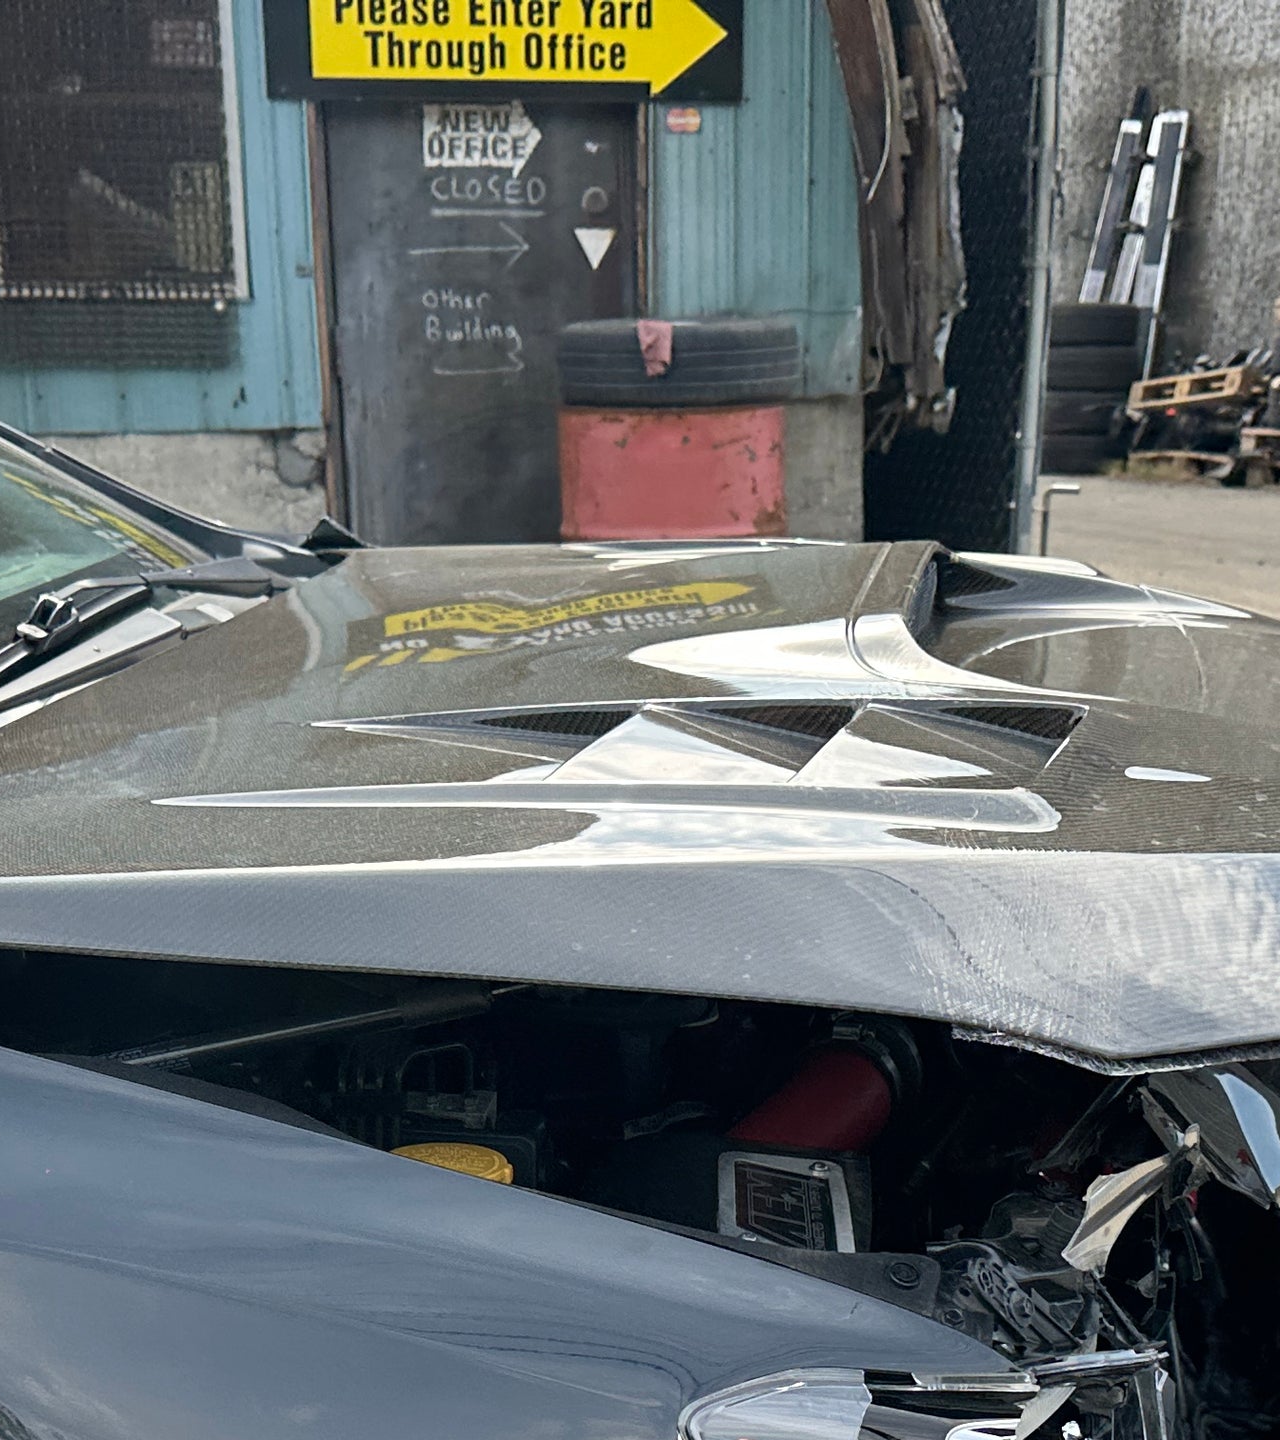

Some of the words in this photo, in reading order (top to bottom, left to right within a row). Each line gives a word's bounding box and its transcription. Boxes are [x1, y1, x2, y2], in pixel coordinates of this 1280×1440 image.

[334, 0, 450, 26] Please
[469, 0, 561, 27] Enter
[582, 0, 653, 29] Yard
[364, 31, 507, 75] Through
[524, 32, 627, 71] Office
[438, 109, 511, 134] NEW
[428, 131, 527, 159] OFFICE
[431, 175, 546, 205] CLOSED
[425, 314, 523, 352] Building
